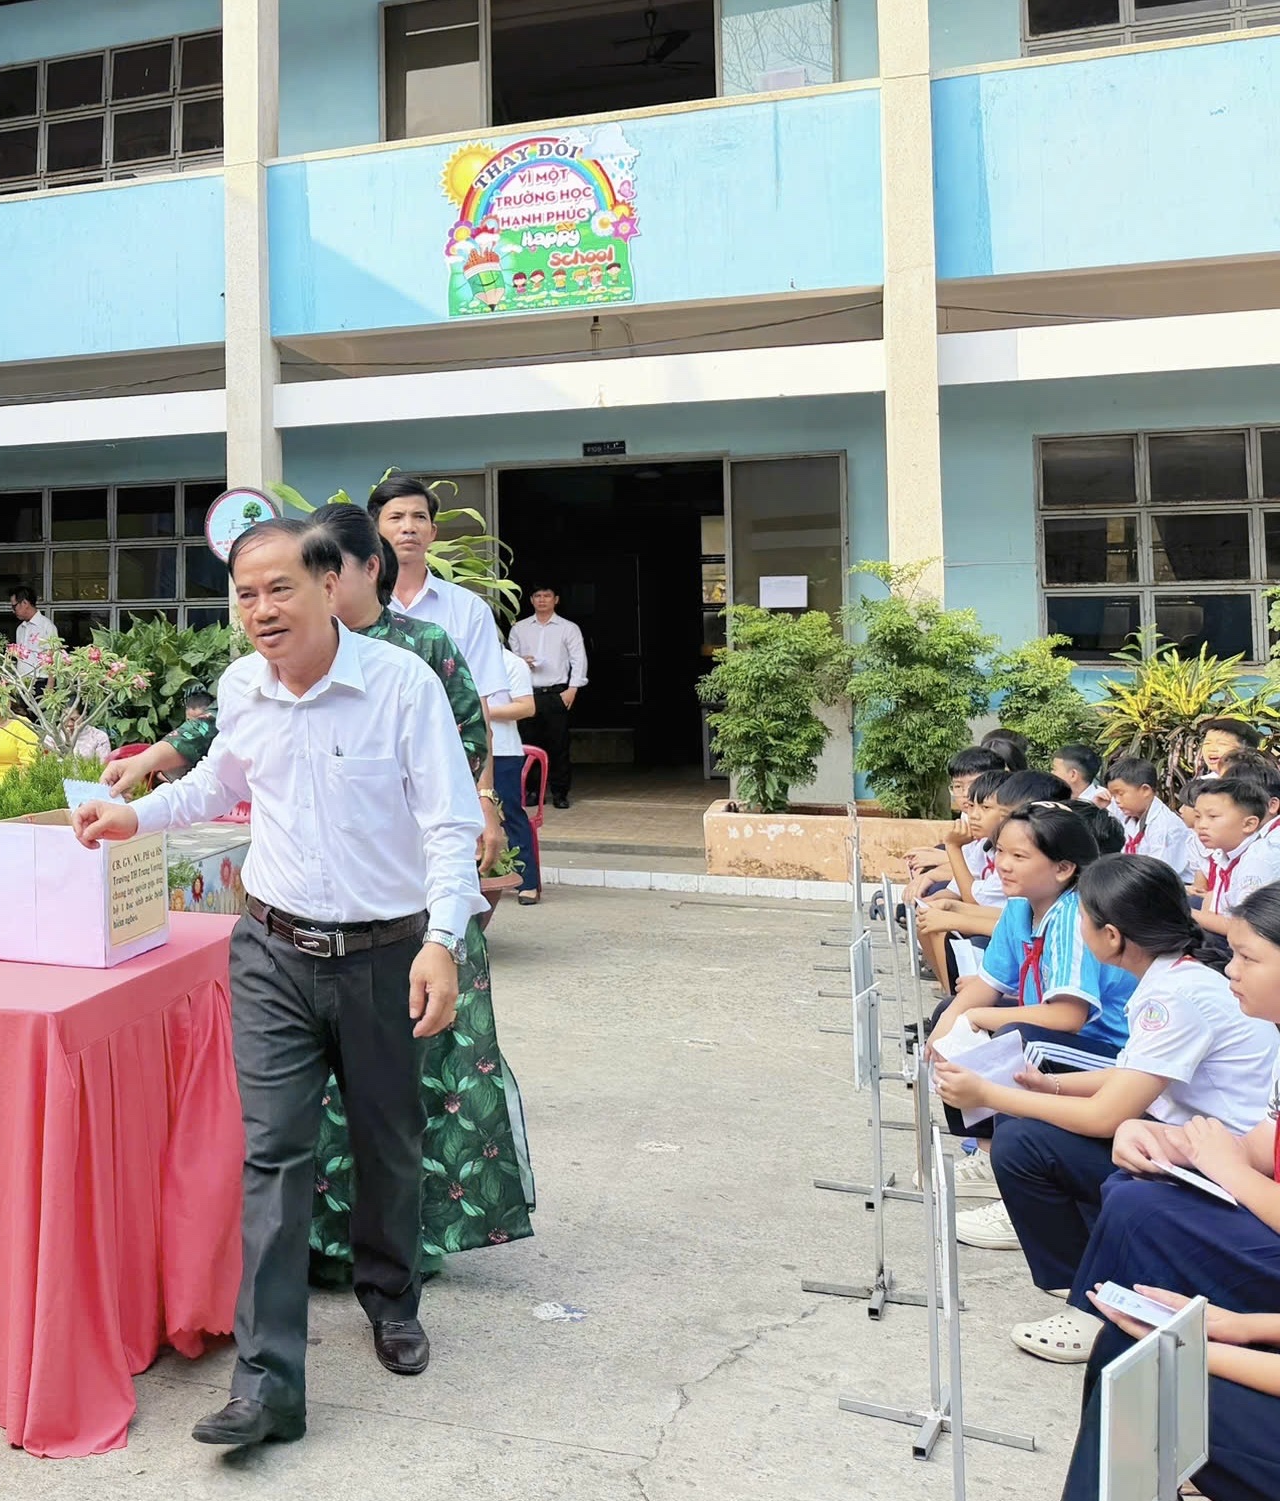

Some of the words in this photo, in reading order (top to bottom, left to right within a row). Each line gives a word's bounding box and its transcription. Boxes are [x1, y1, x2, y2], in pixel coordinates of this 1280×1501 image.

[474, 146, 529, 189] THAY
[538, 136, 579, 159] ĐỔI
[518, 170, 531, 183] VÌ
[536, 167, 568, 184] MỘT
[495, 190, 556, 208] TRƯỜNG
[560, 187, 593, 202] HỌC
[501, 213, 541, 229] HẠNH
[547, 206, 587, 222] PHÚC
[521, 229, 581, 249] Happy
